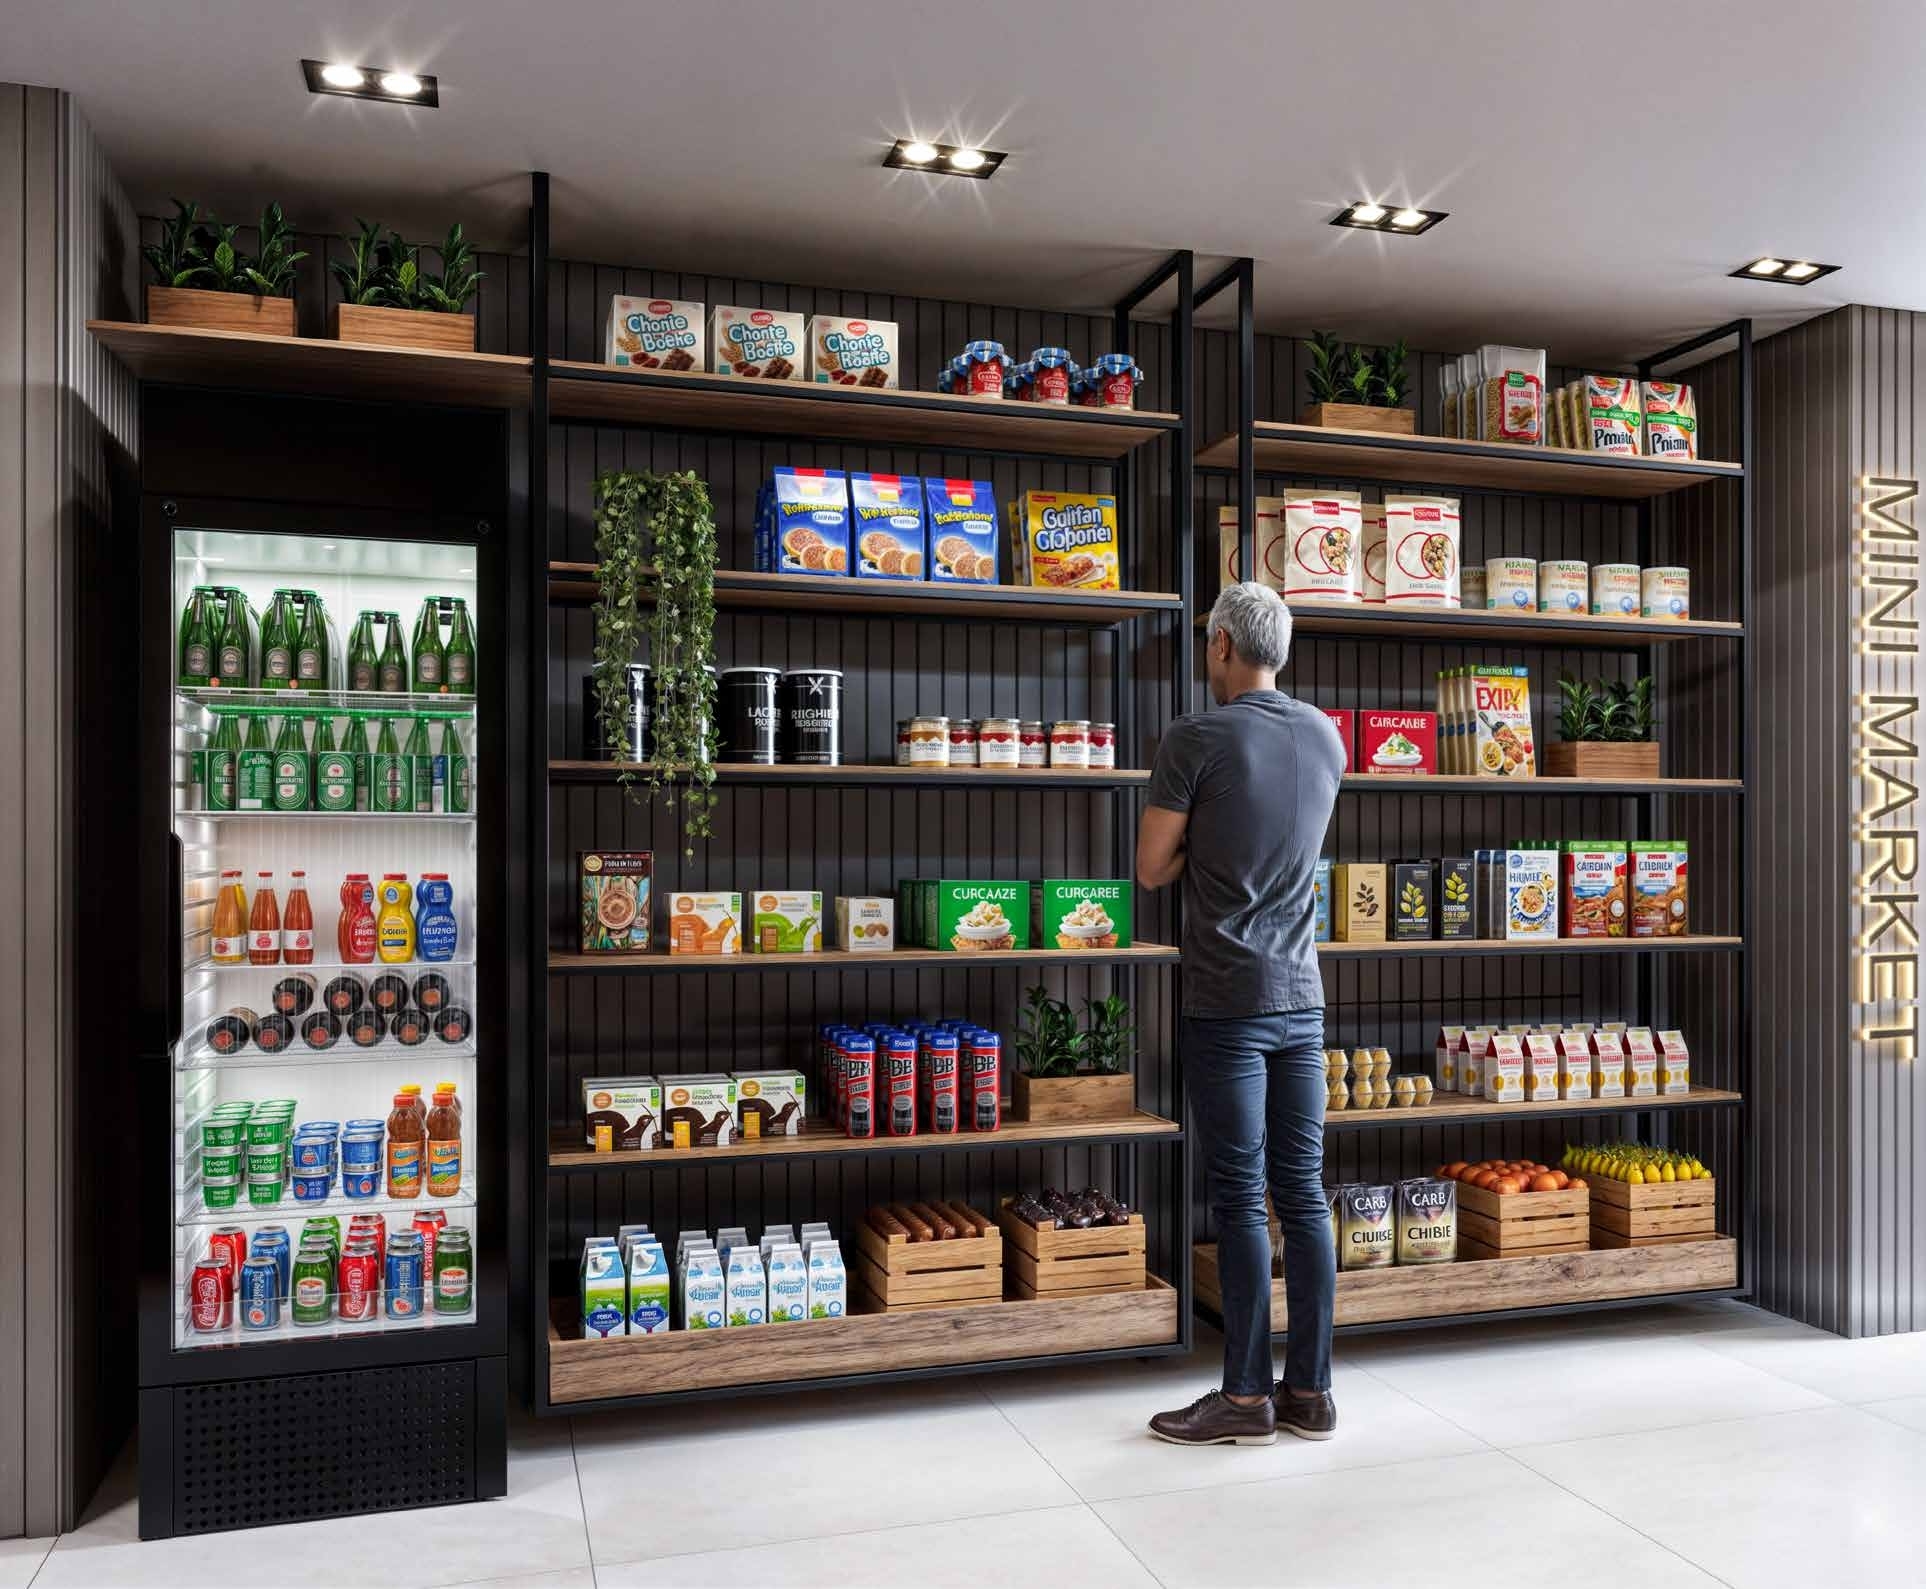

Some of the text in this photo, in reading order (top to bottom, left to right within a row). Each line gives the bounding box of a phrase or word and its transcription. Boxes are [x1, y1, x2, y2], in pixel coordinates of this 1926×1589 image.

[1866, 476, 1919, 1059] MINI MARKET
[1355, 1195, 1387, 1211] CARB
[1411, 1192, 1446, 1207] CARB
